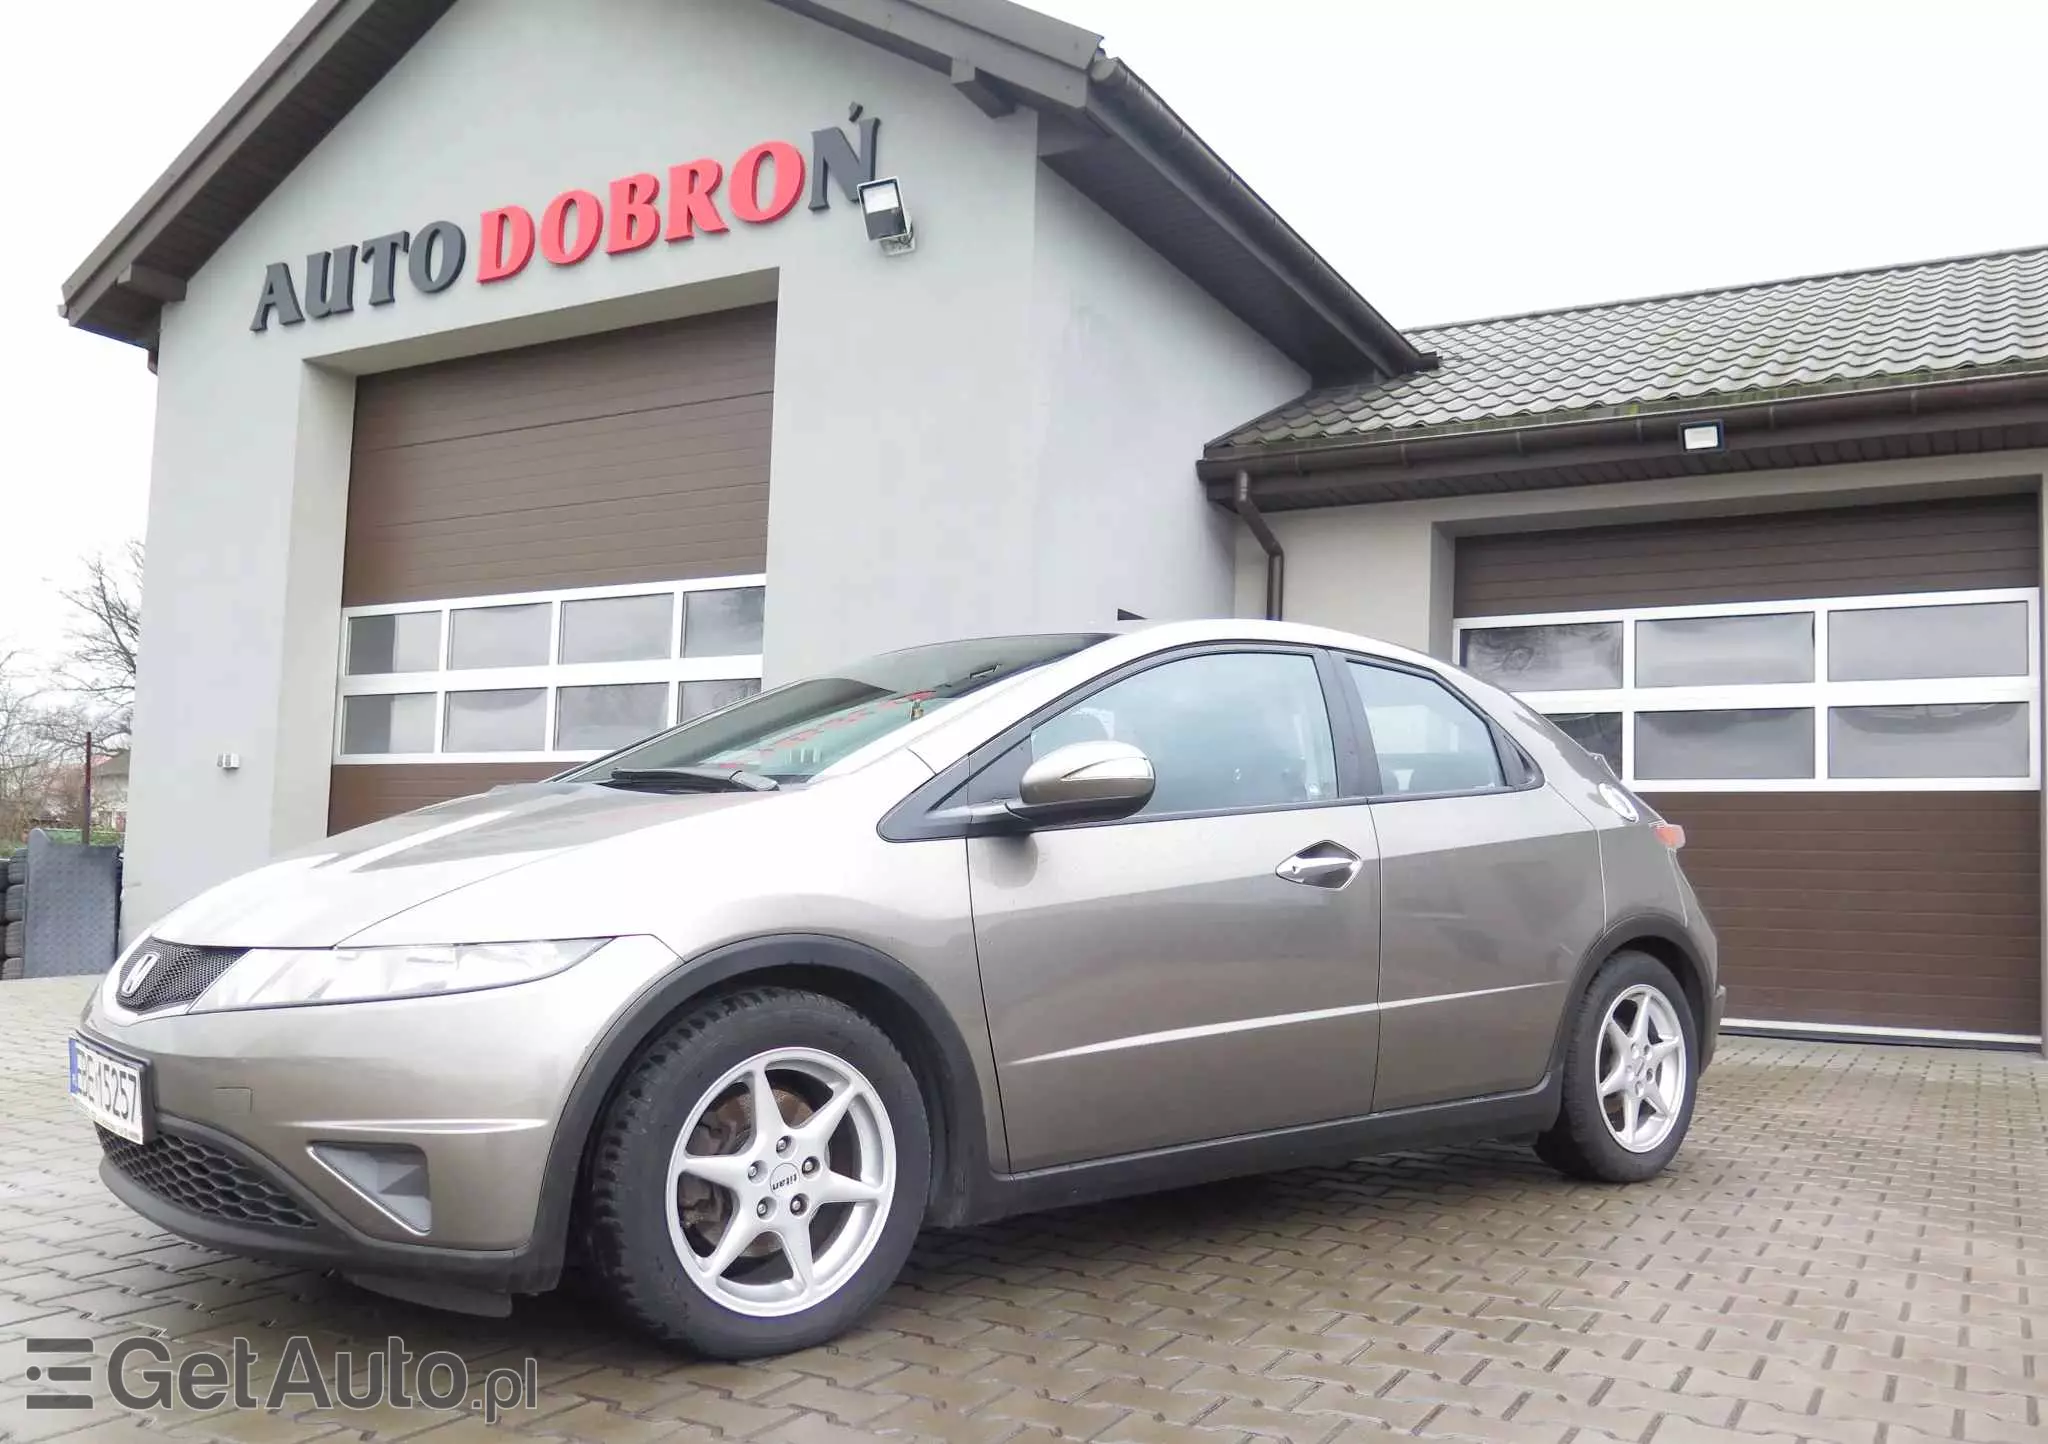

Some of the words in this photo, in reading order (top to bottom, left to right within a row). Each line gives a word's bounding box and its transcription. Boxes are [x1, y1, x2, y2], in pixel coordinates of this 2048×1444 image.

[250, 220, 466, 332] AUTO
[477, 101, 881, 284] DOBROŃ
[773, 1174, 797, 1190] titan
